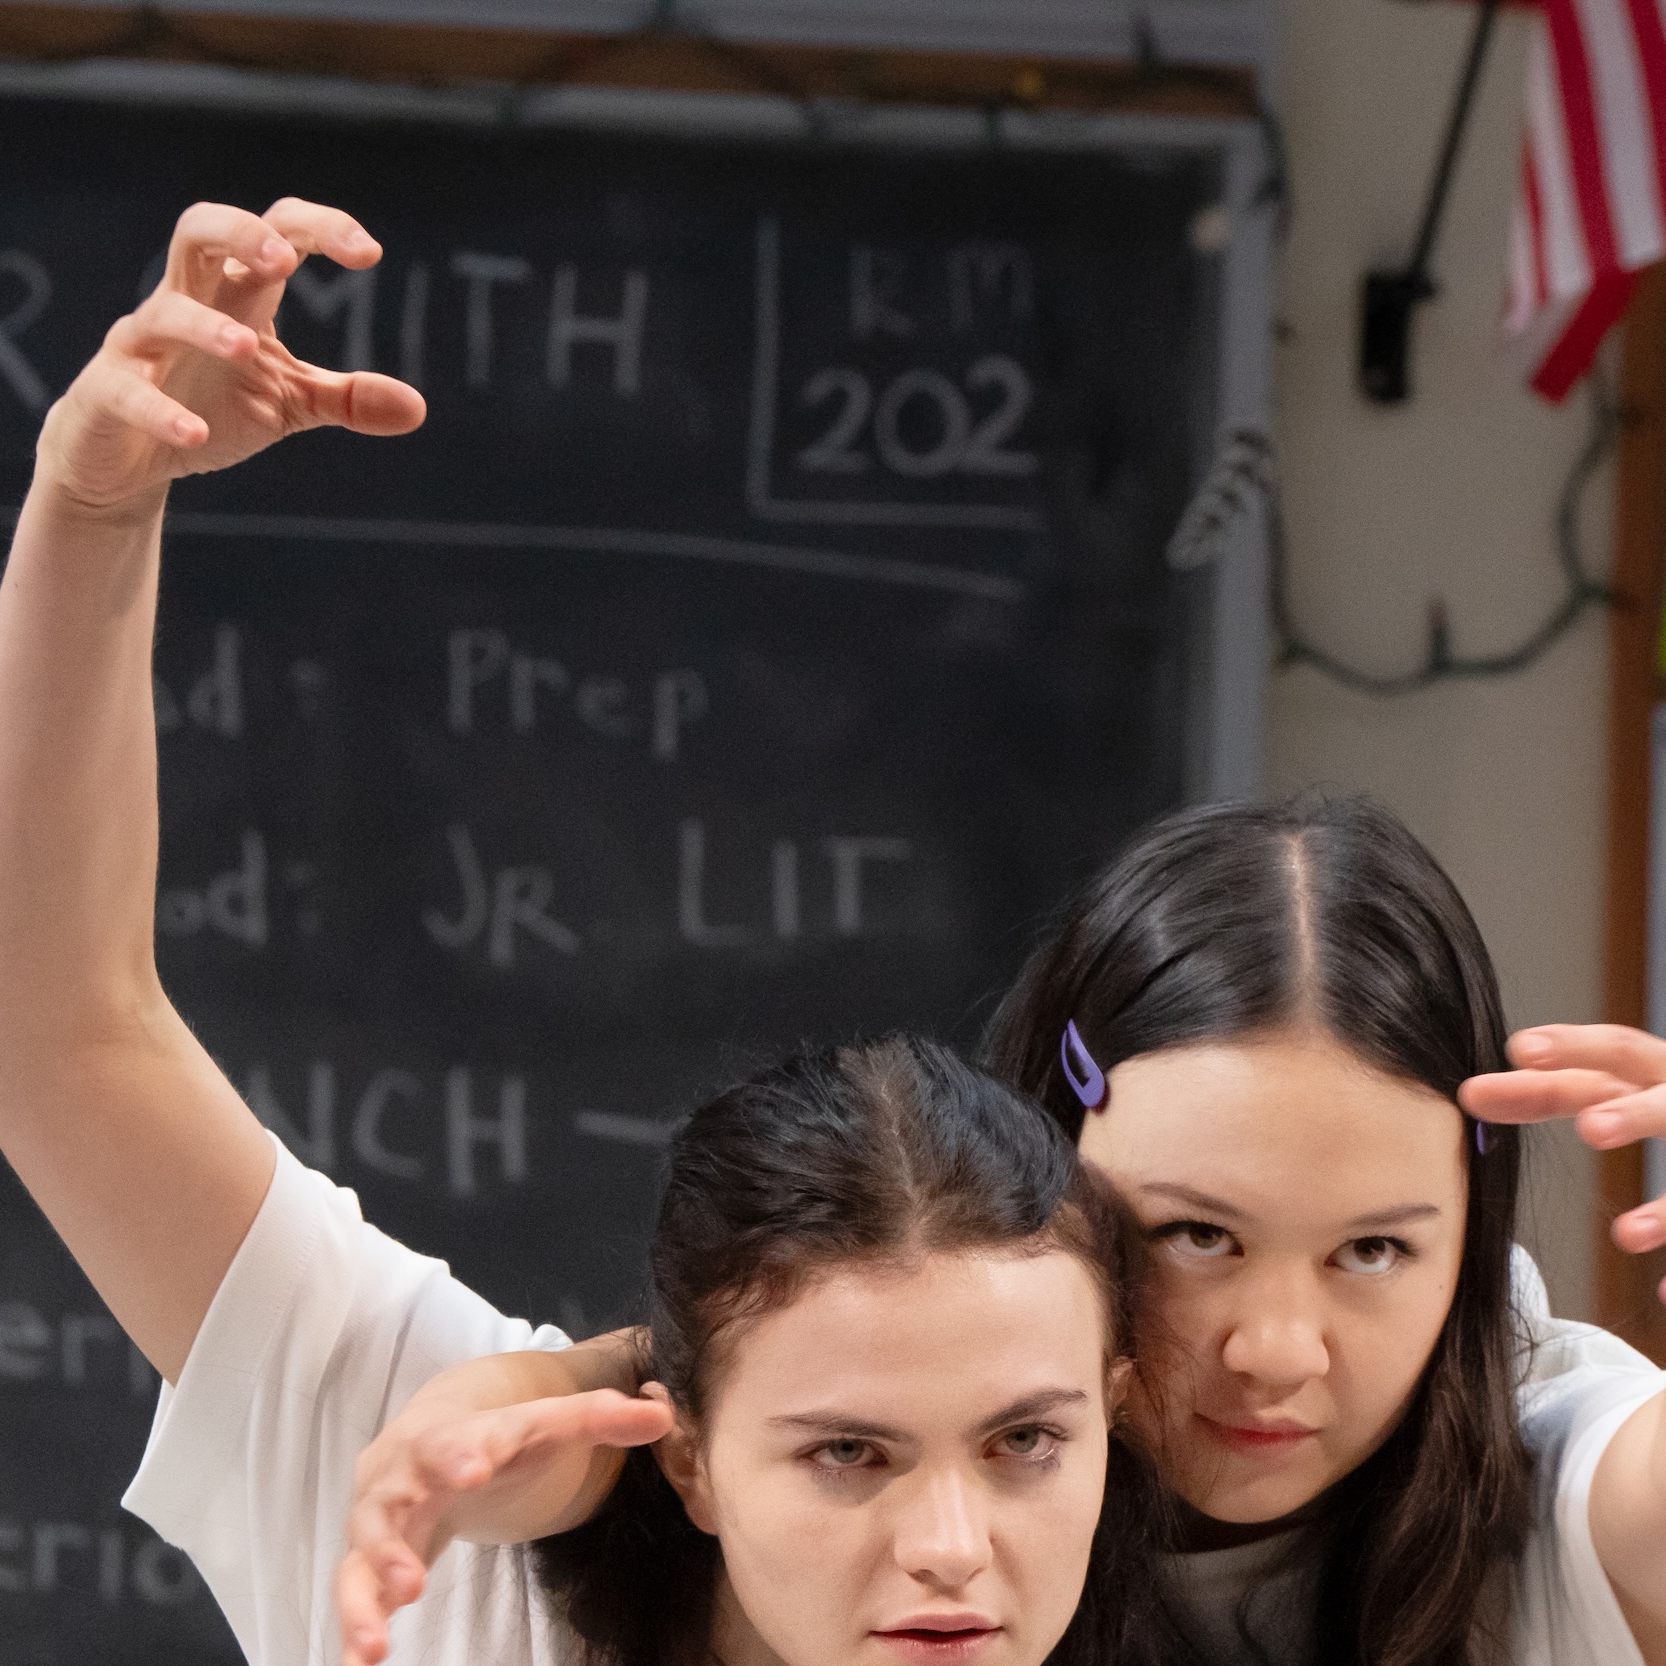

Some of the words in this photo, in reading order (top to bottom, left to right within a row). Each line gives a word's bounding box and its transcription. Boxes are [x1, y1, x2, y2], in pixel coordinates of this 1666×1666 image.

[141, 252, 649, 394] MITH
[797, 356, 1037, 478] 202
[447, 628, 709, 762] Prep
[678, 818, 913, 948] LIT
[241, 1062, 529, 1196] NCH
